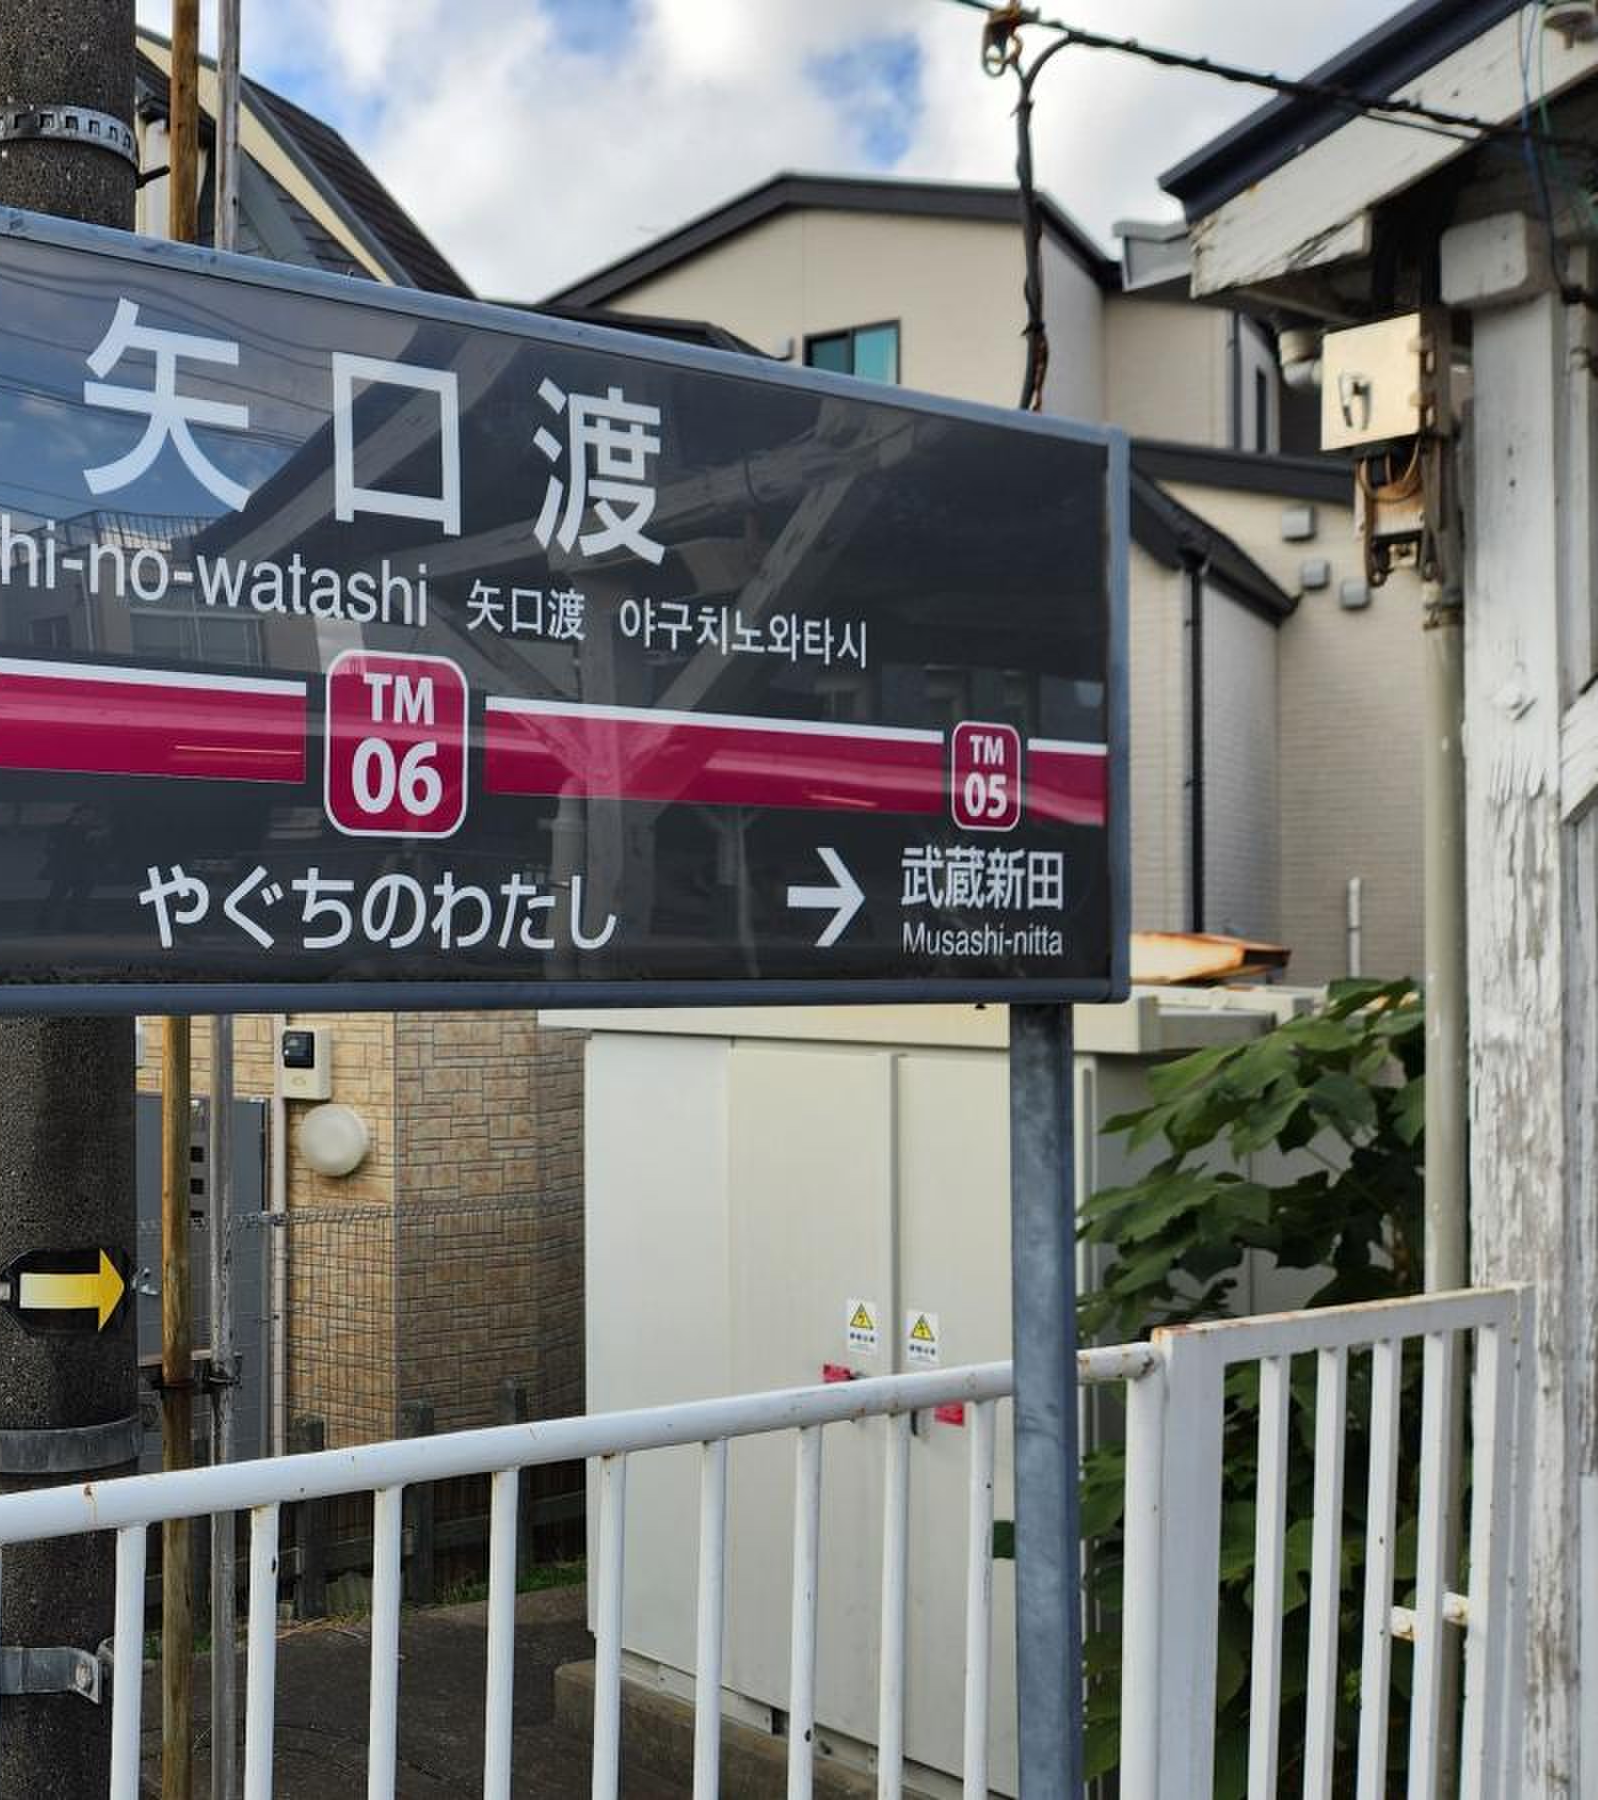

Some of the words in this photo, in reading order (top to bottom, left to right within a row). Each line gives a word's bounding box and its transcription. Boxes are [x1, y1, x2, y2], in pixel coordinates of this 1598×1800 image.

[84, 297, 665, 564] 矢口渡
[466, 579, 586, 641] 矢口渡
[619, 597, 868, 669] 야구치노와타시
[363, 673, 435, 725] TM
[352, 738, 443, 816] 06
[969, 735, 1004, 766] TM
[964, 772, 1008, 818] 05
[137, 863, 616, 950] やぐちのわたし
[901, 844, 1064, 911] 武蔵新田
[902, 922, 1064, 956] Musashi-nitta
